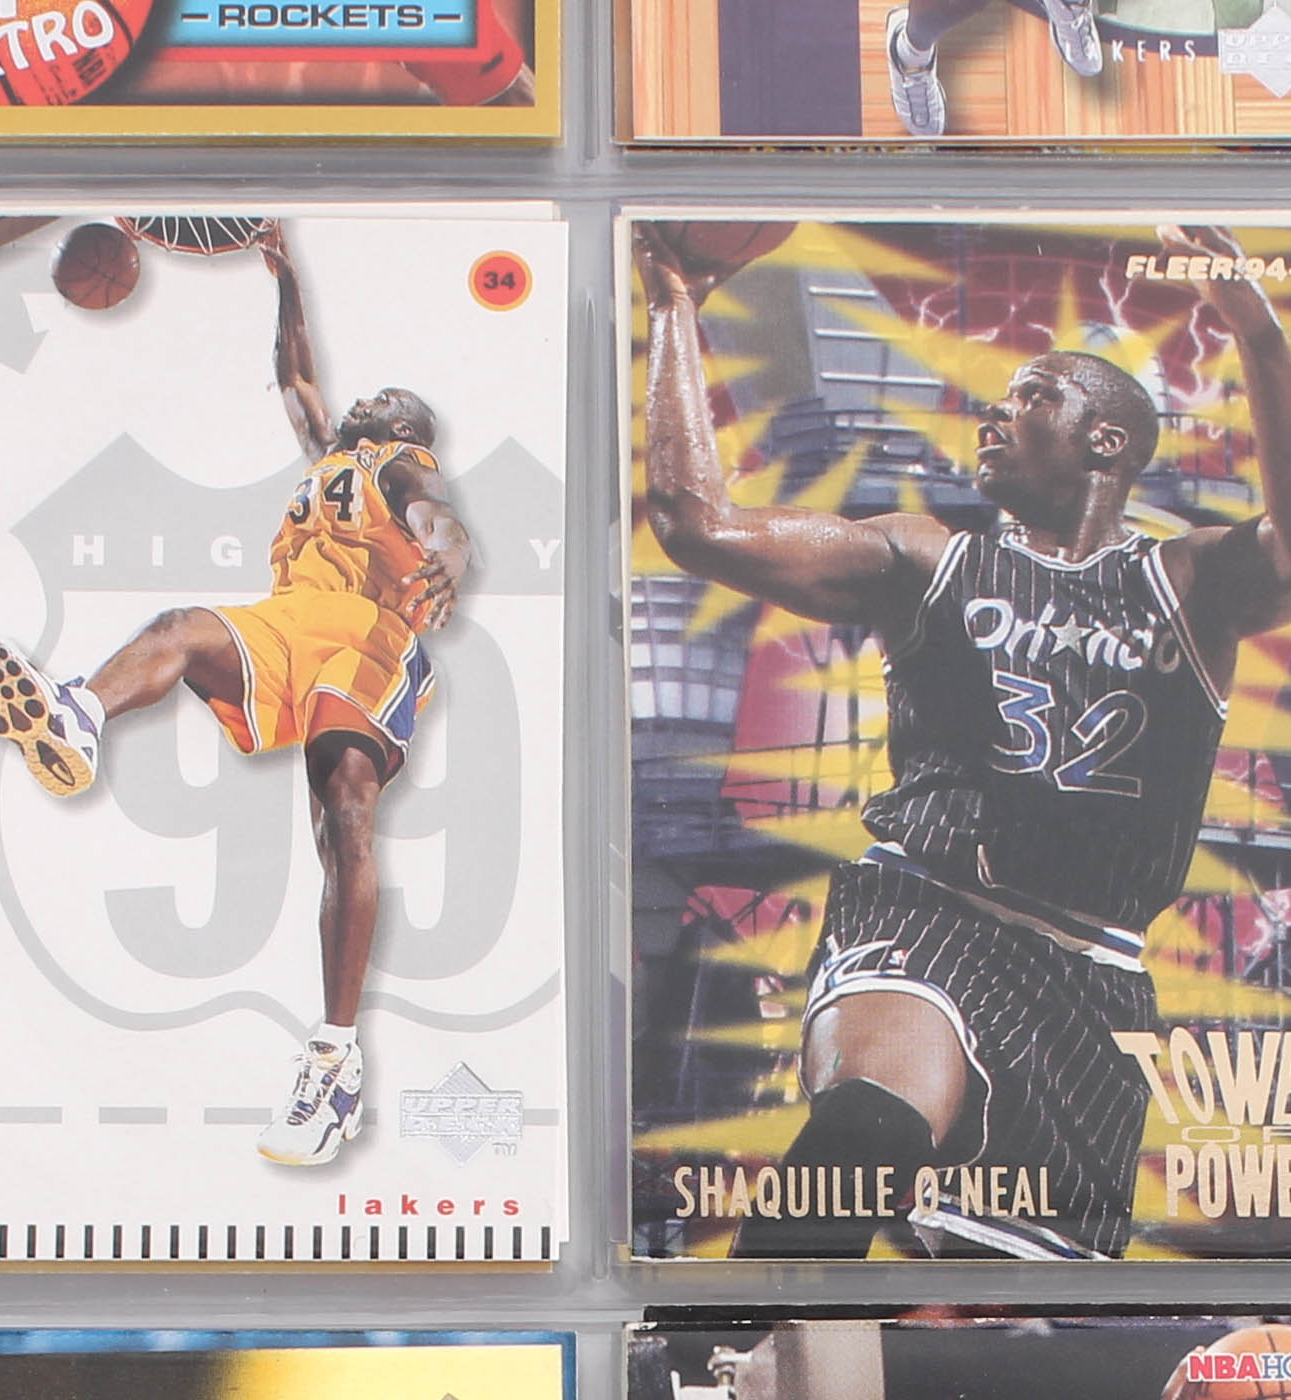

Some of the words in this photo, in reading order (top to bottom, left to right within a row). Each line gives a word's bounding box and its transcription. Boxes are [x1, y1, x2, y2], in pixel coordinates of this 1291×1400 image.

[217, 4, 425, 29] ROCKETS
[483, 271, 517, 290] 34
[73, 535, 561, 569] HIGY
[989, 670, 1150, 799] 32
[338, 1194, 520, 1216] lakers
[674, 1165, 896, 1220] SHAQUILLE
[913, 1165, 1058, 1217] O'NEAL
